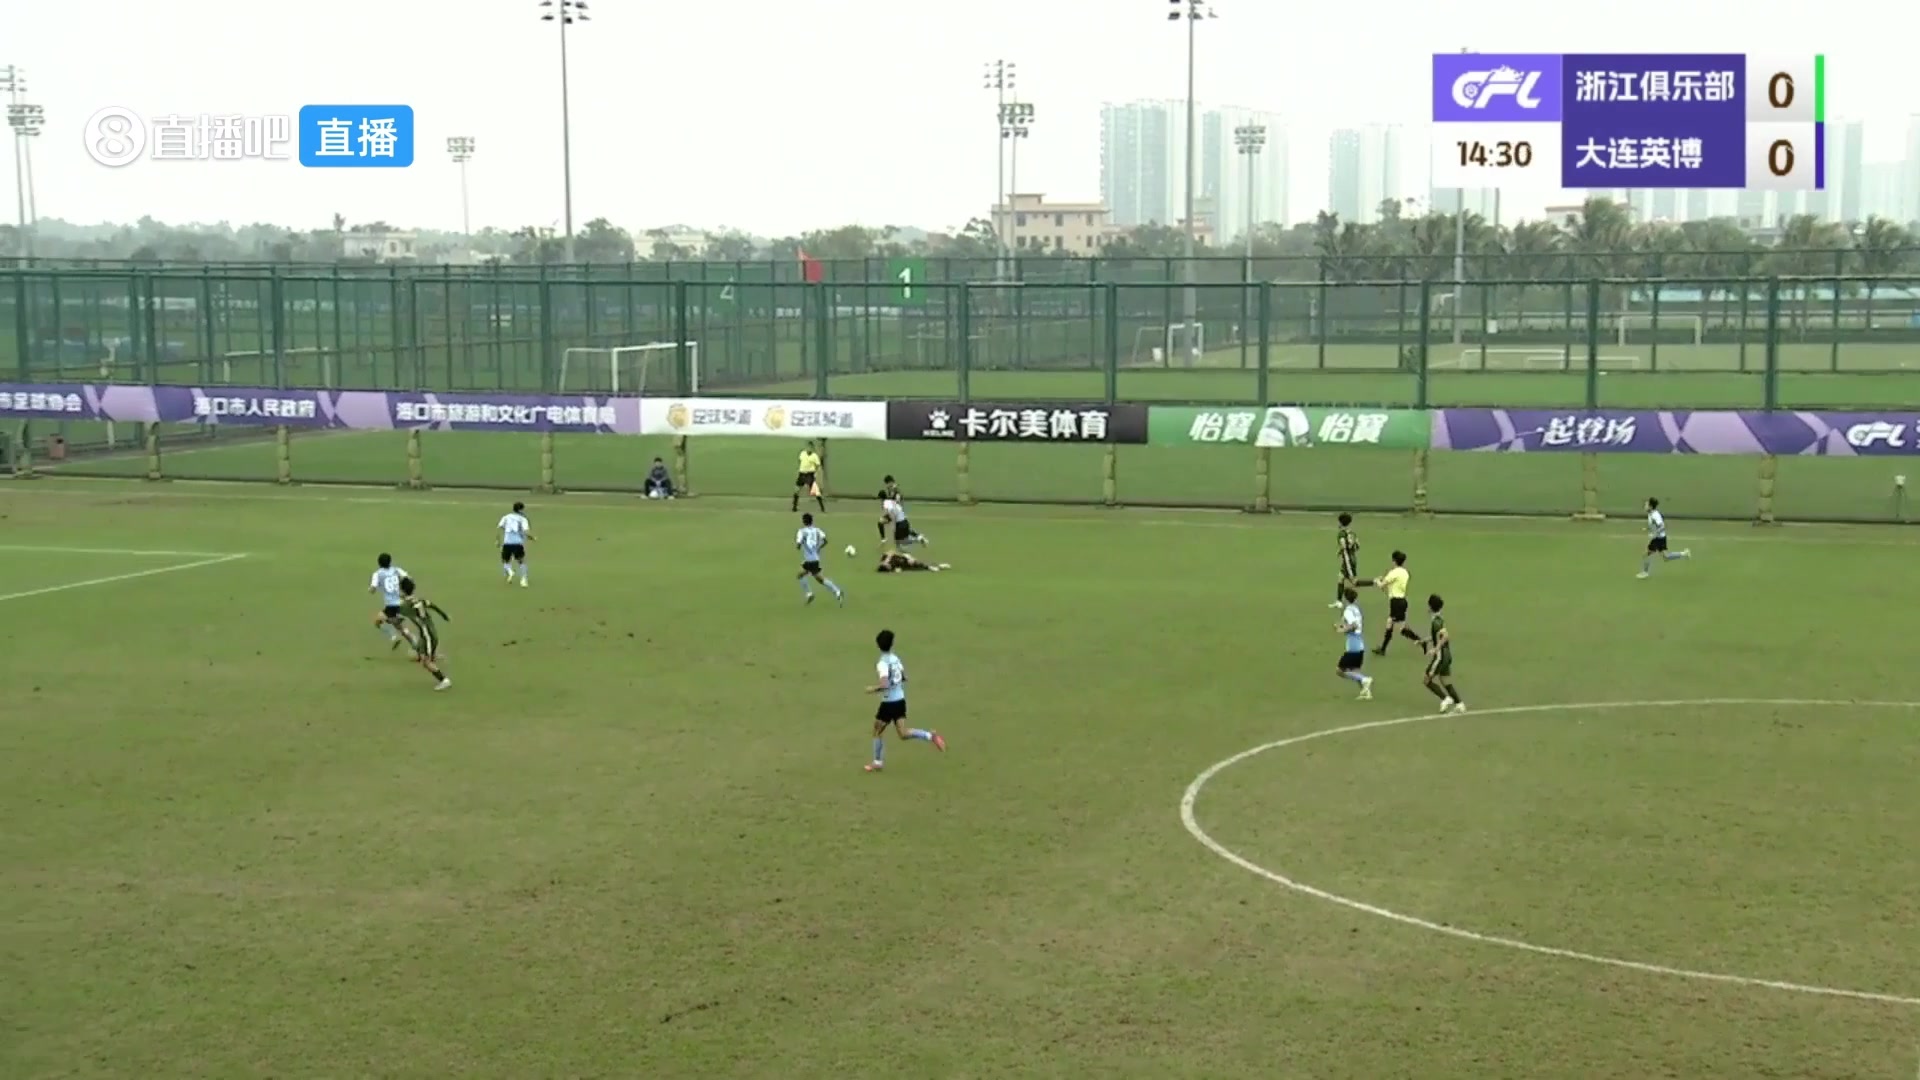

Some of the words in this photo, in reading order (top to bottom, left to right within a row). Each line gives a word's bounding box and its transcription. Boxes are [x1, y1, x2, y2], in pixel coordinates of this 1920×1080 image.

[898, 267, 912, 299] 1
[194, 397, 316, 418] 海口市人民政府
[396, 402, 617, 425] 海口市旅游和文化广电体育局
[958, 408, 1109, 439] 卡尔美体育
